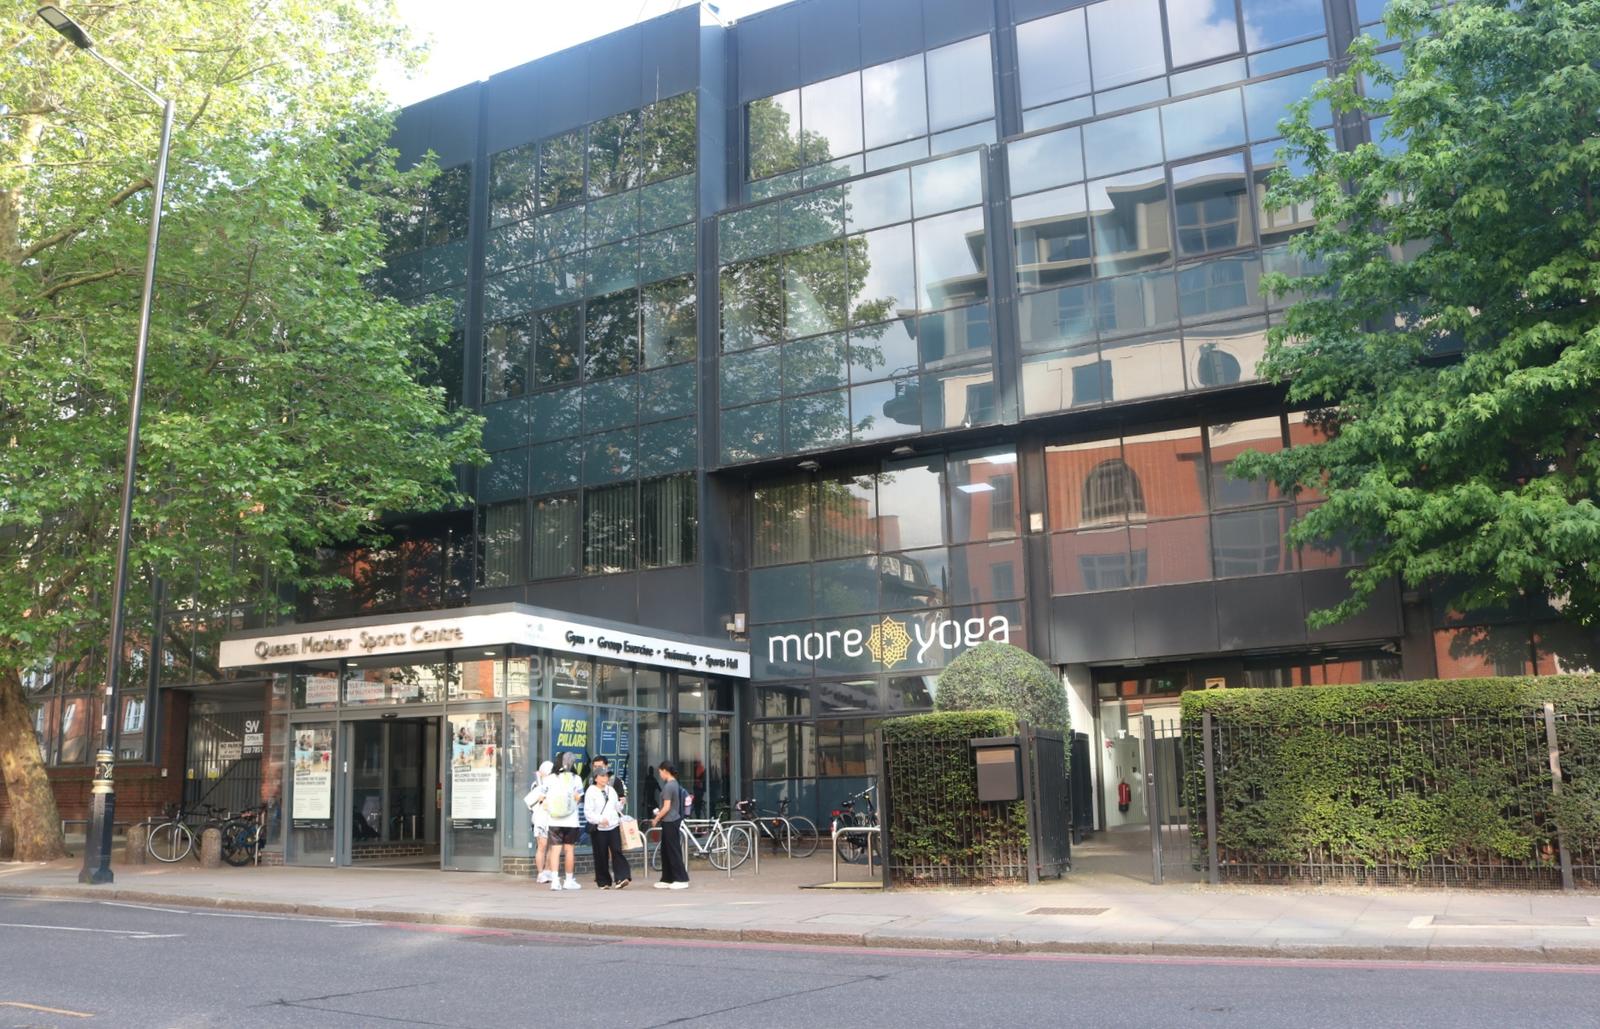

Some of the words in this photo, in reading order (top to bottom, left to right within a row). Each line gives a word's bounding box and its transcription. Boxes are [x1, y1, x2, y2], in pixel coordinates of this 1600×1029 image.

[254, 640, 299, 660] Queen
[301, 634, 353, 655] Mother
[359, 630, 406, 653] Sports
[410, 625, 464, 645] Centre
[565, 630, 586, 648] Gym
[597, 636, 622, 654] Group
[623, 641, 654, 657] Exercise
[663, 647, 697, 666] Swimming
[705, 654, 726, 668] Sports
[726, 657, 739, 670] Hall
[768, 628, 864, 664] more
[914, 615, 1010, 664] yoga
[246, 720, 260, 733] SW
[560, 719, 576, 733] THE
[575, 719, 588, 733] SIX
[556, 733, 588, 748] PILLARS
